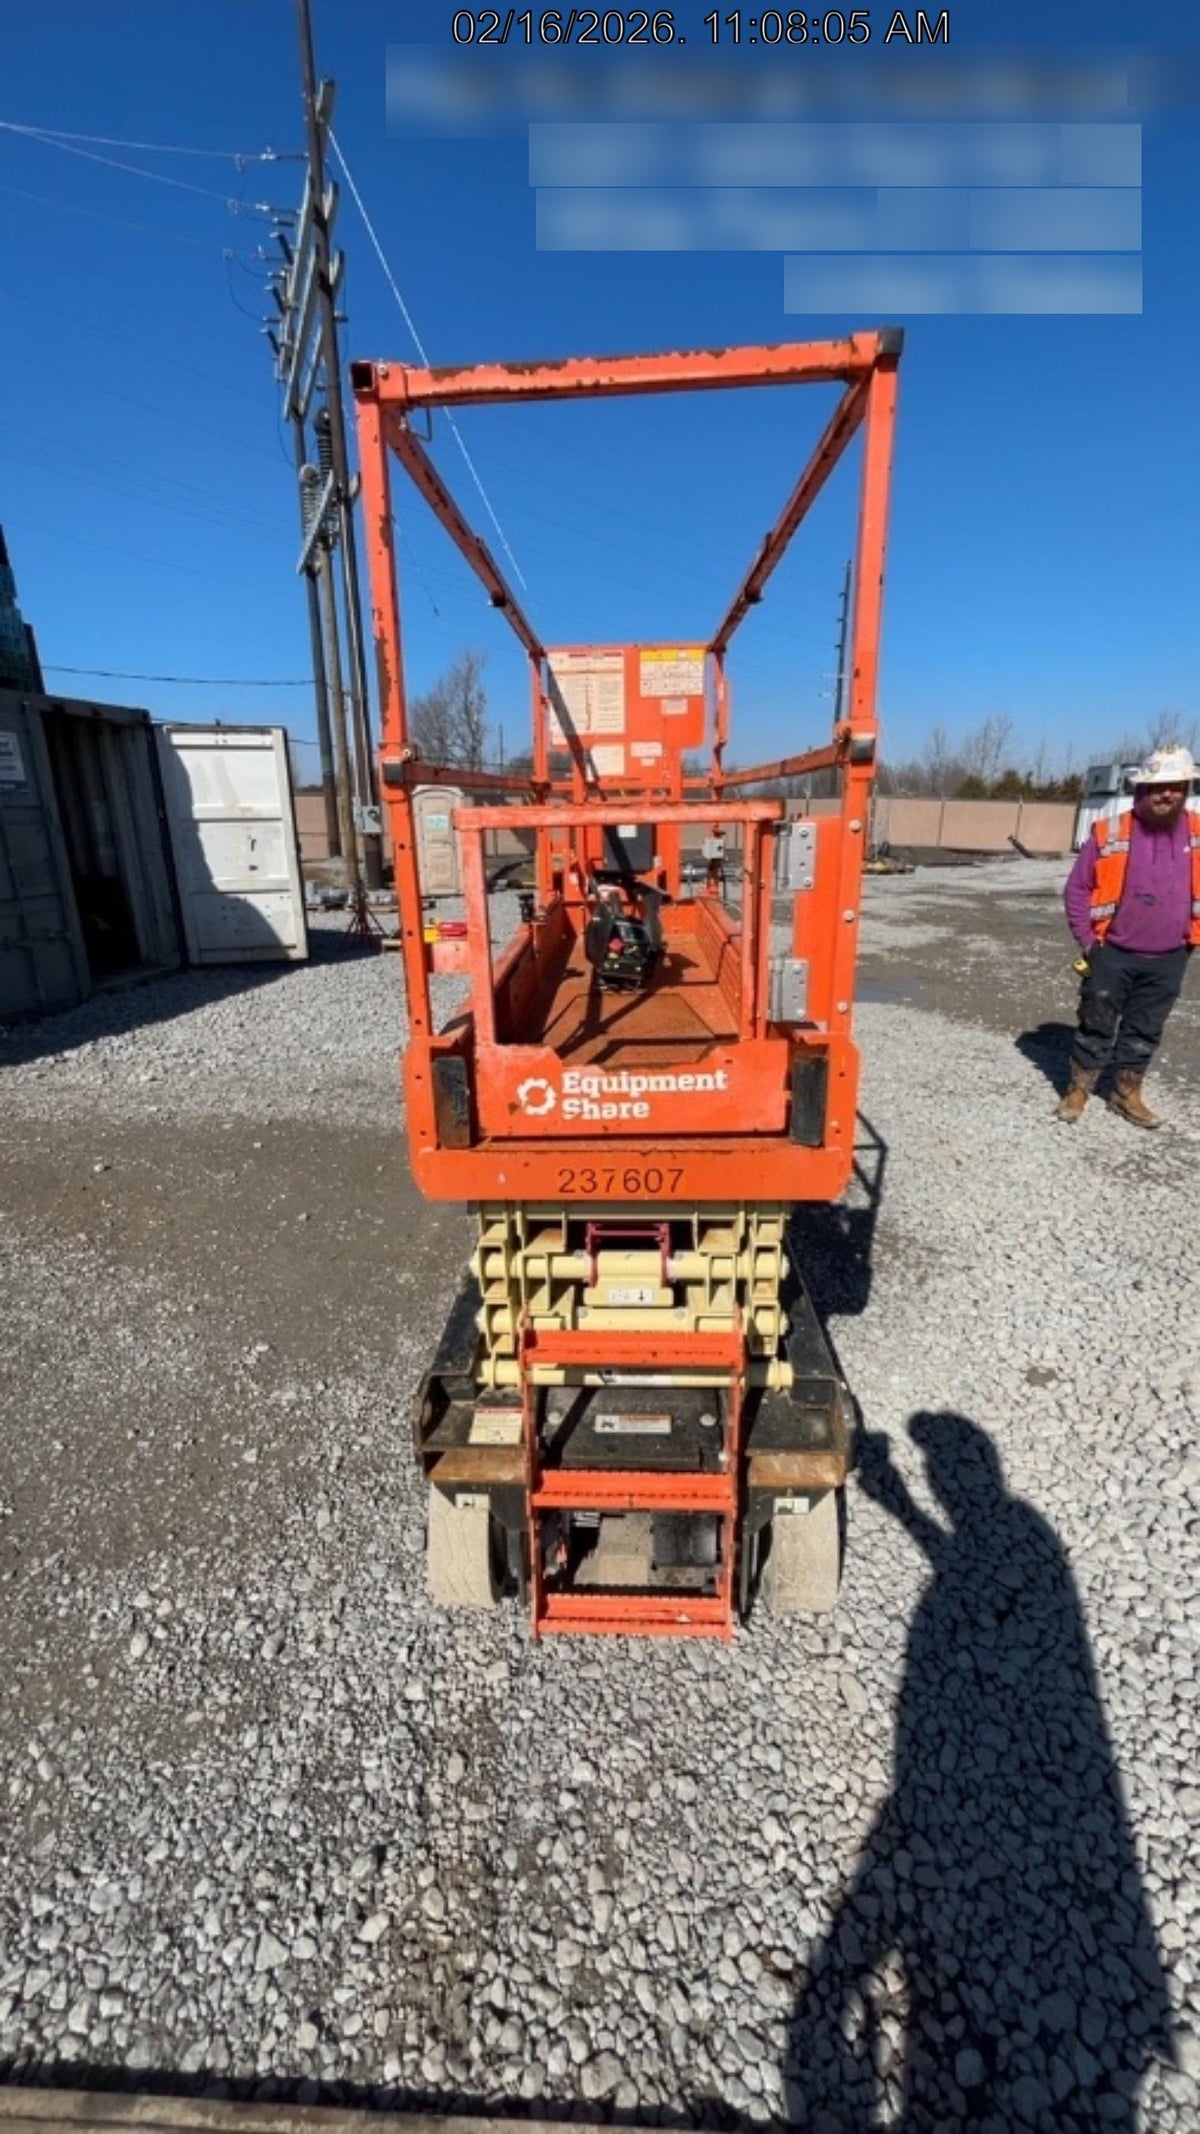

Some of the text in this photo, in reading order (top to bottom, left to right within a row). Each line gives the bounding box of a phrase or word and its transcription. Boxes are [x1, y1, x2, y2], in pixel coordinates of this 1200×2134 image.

[561, 1069, 728, 1098] Equipment
[561, 1097, 650, 1120] Share
[558, 1168, 684, 1193] 237607
